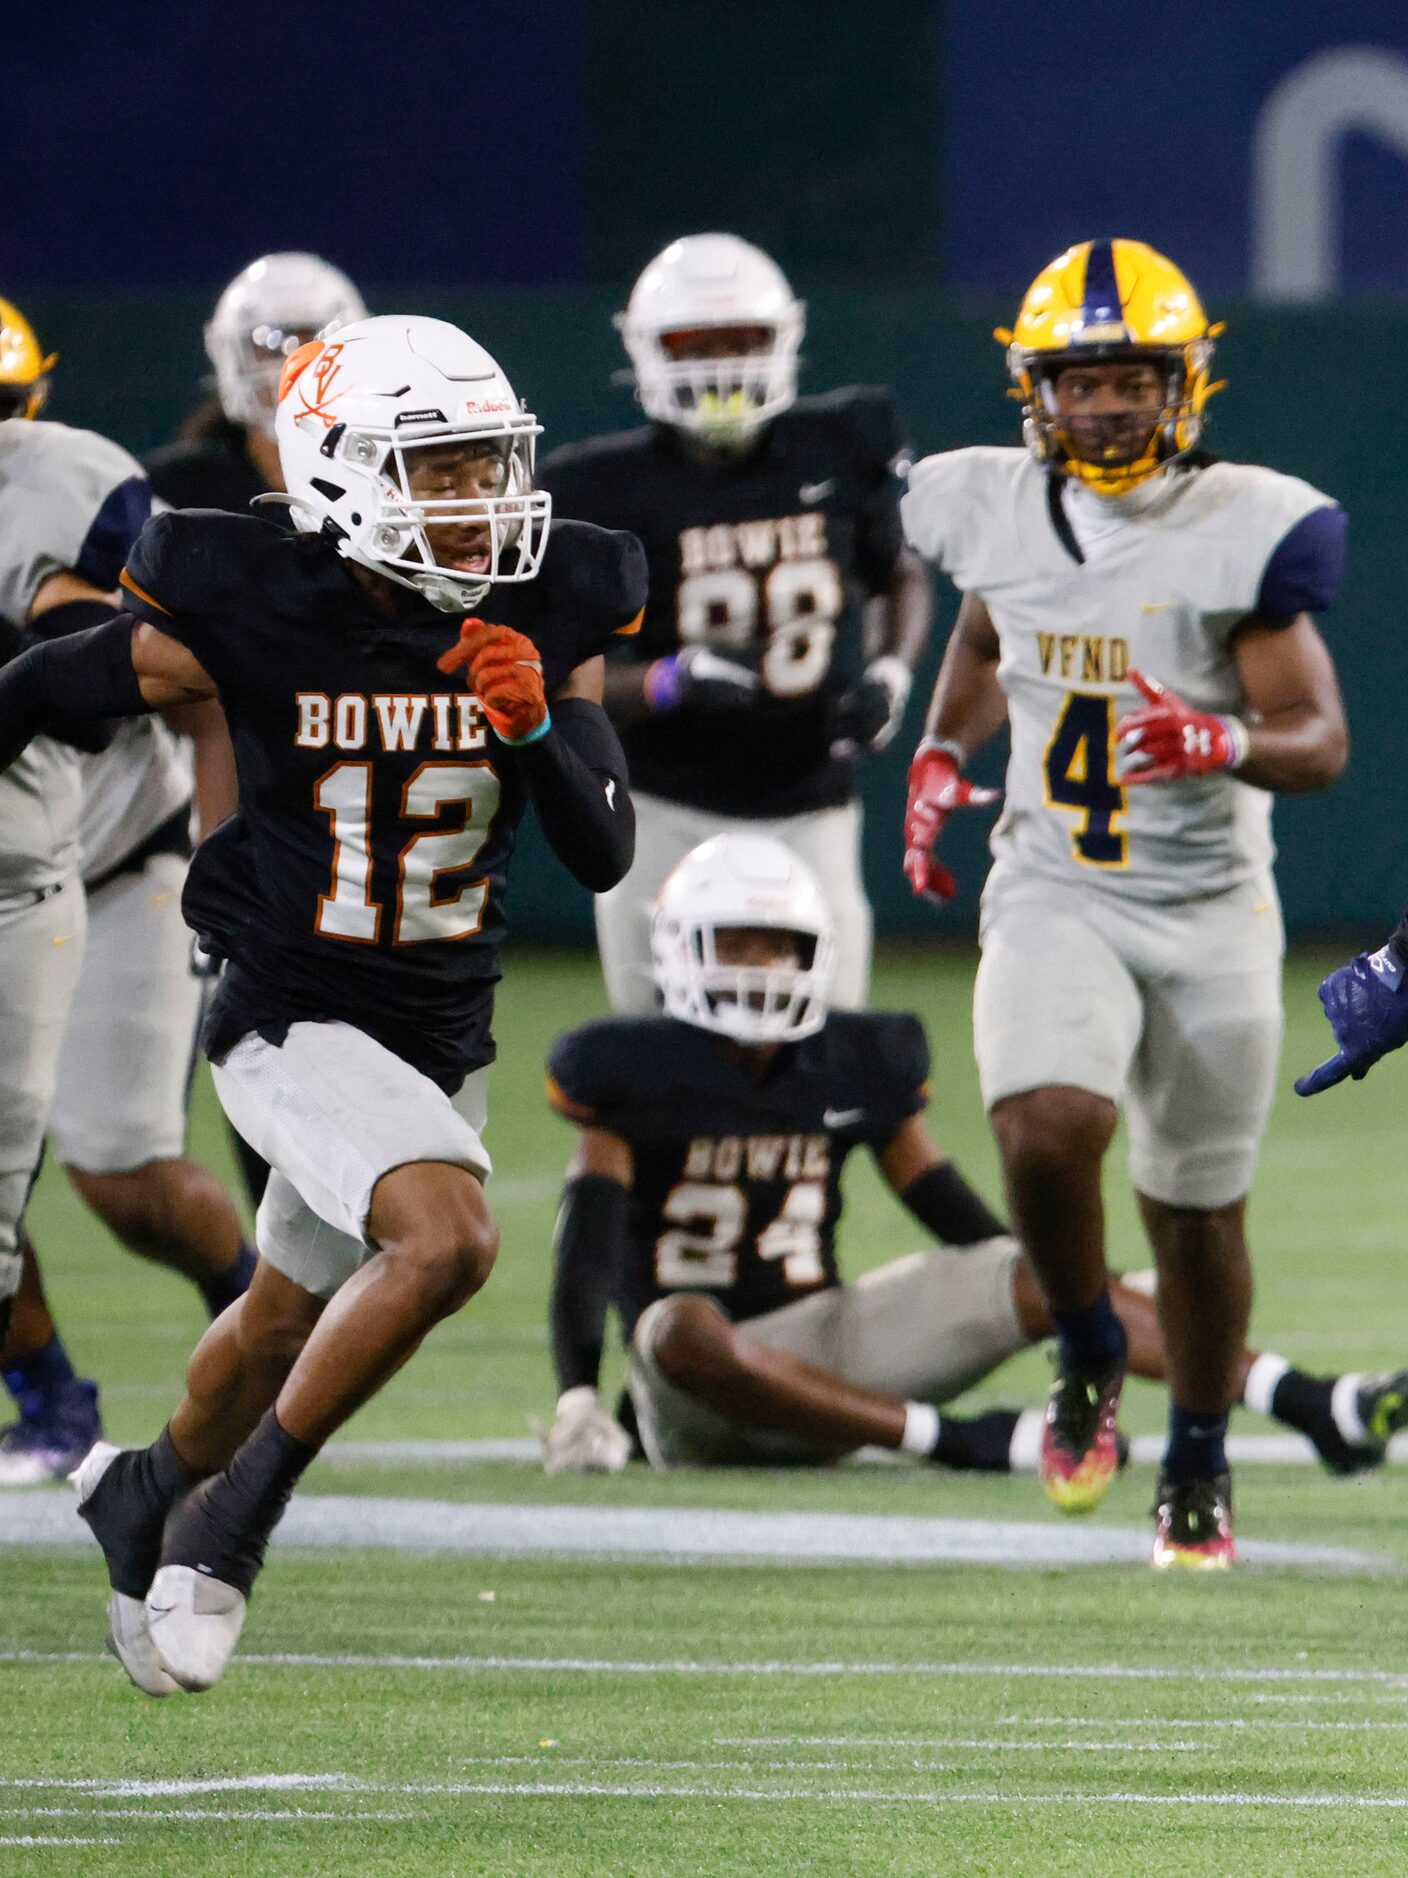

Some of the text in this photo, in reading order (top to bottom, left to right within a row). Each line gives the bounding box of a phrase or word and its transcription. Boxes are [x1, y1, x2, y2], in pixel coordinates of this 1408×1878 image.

[678, 511, 829, 570] BOWIE
[1037, 631, 1129, 683] VFND
[295, 691, 489, 752] BOWIE
[1042, 689, 1131, 873] 4
[312, 759, 502, 947] 12
[684, 1133, 832, 1179] BOWIE
[655, 1178, 827, 1290] 24
